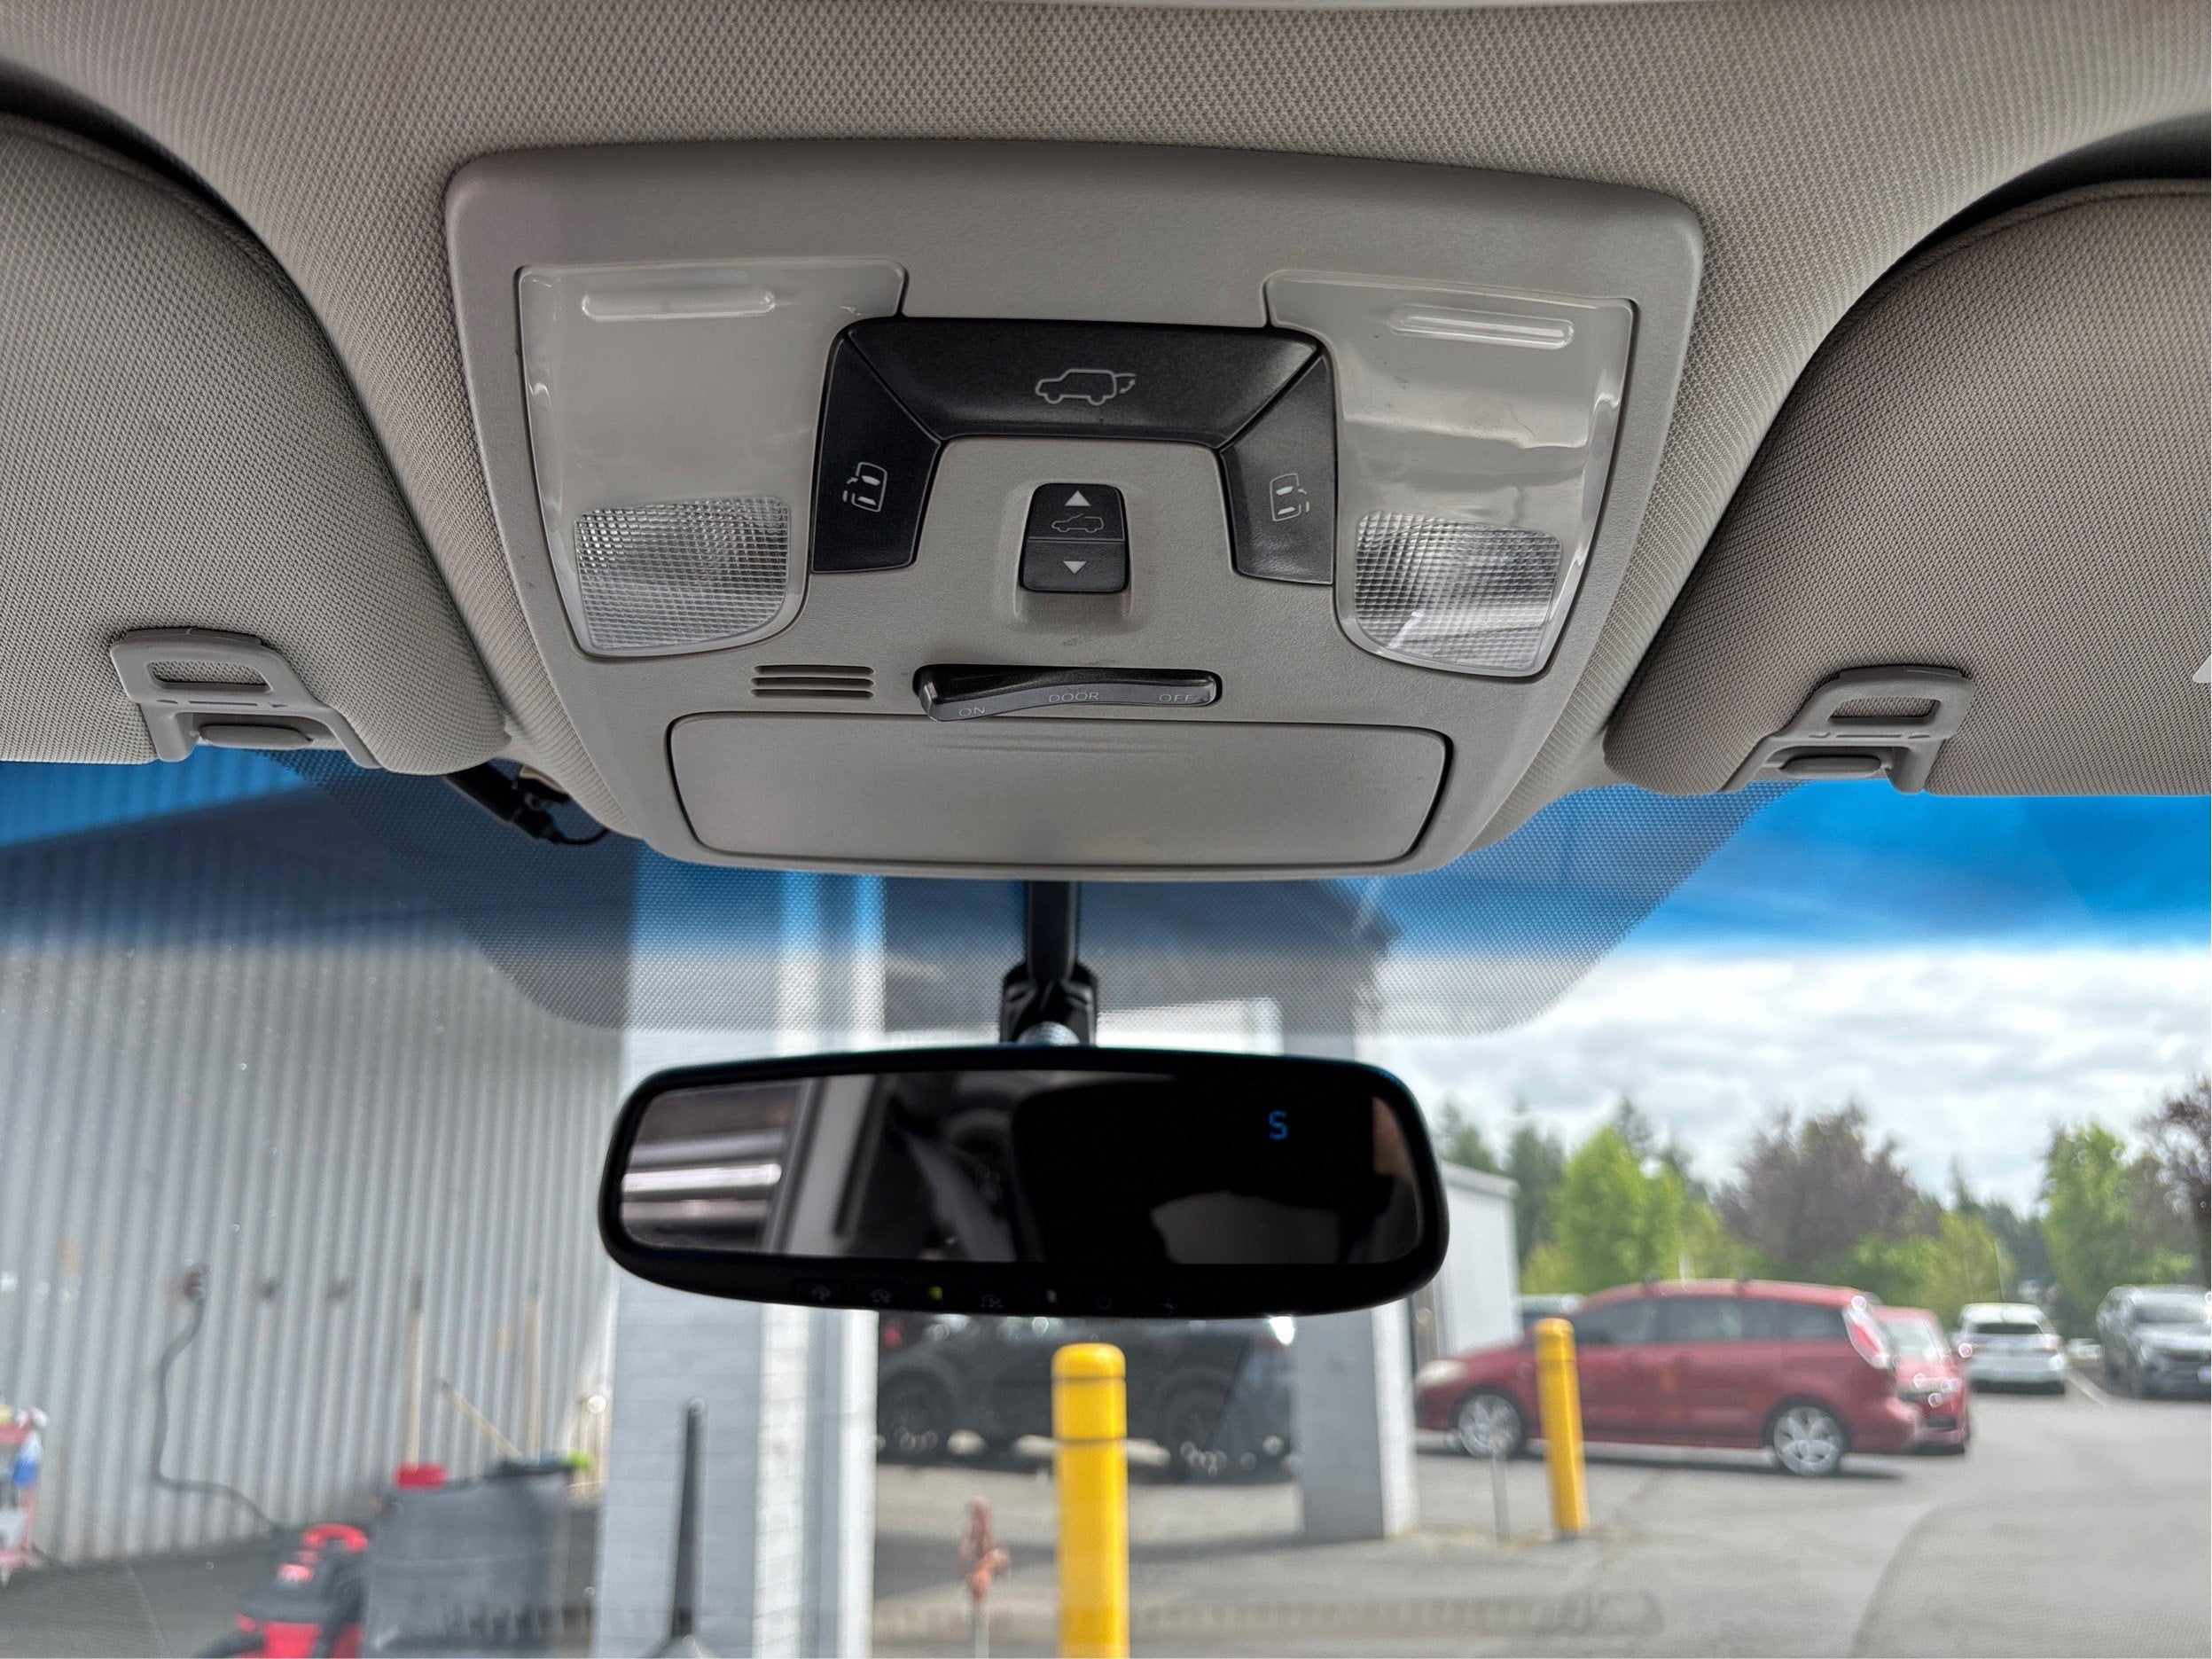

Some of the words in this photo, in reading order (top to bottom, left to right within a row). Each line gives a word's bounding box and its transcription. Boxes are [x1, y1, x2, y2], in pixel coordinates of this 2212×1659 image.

[958, 706, 986, 717] ON
[1048, 692, 1099, 703] DOOR
[1159, 693, 1194, 702] OFF
[1268, 1110, 1289, 1140] S
